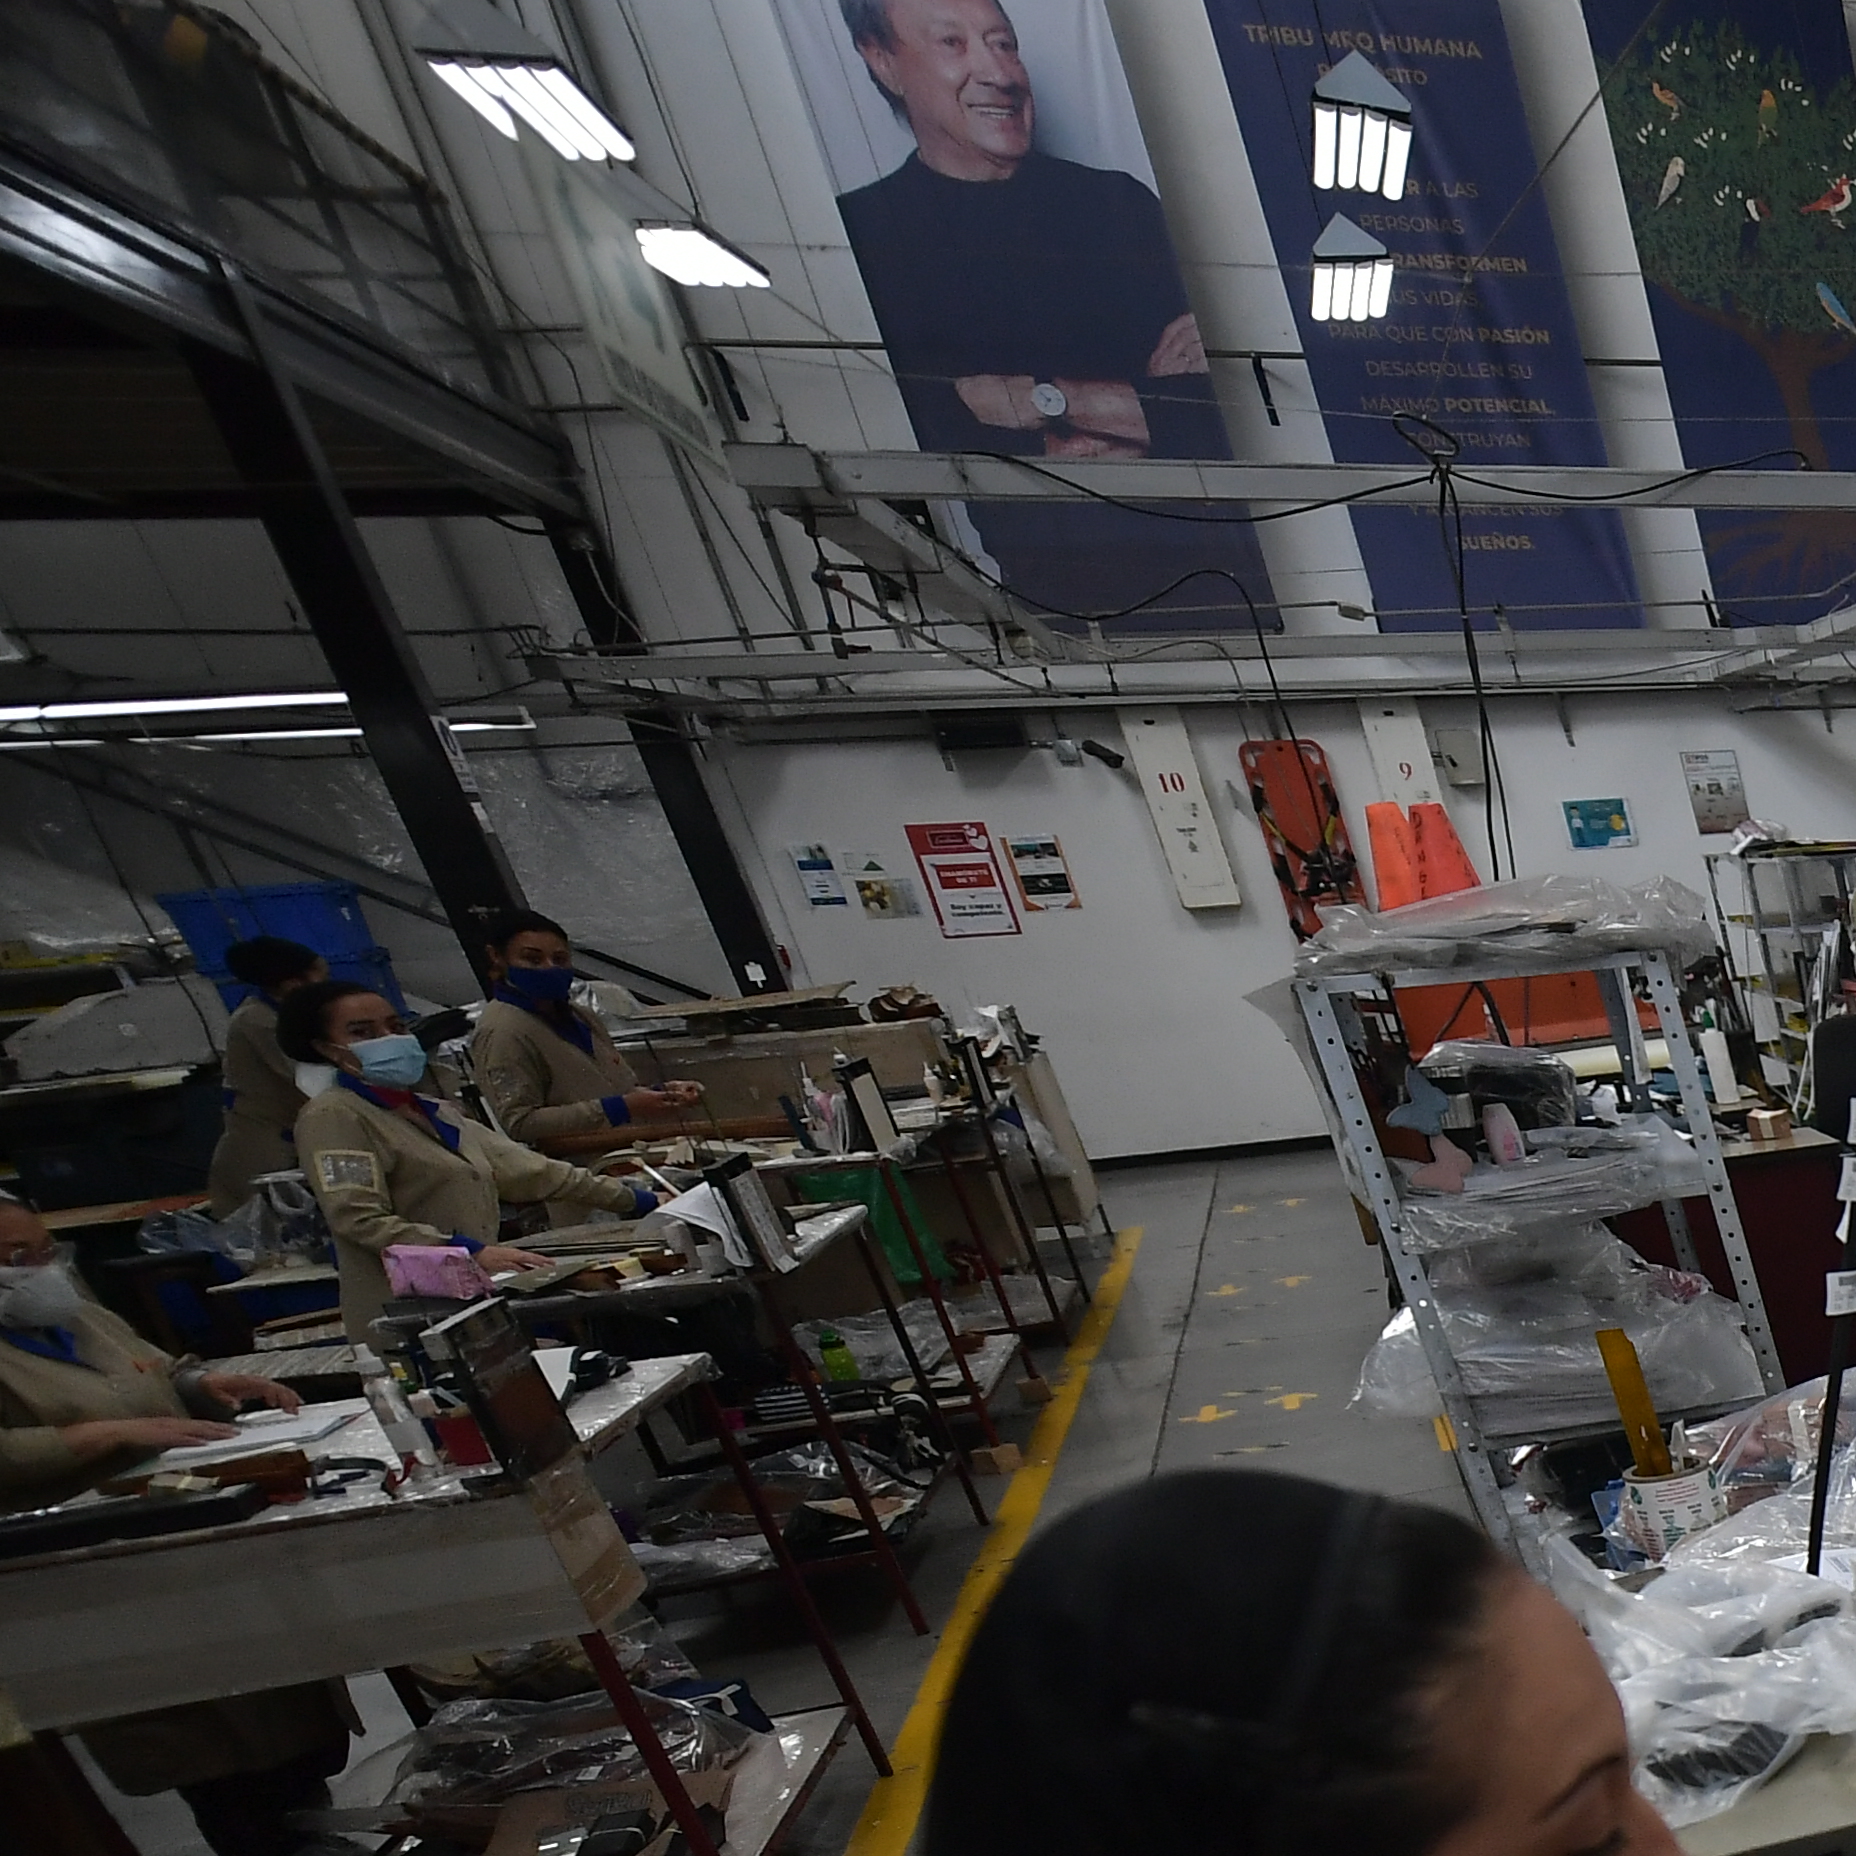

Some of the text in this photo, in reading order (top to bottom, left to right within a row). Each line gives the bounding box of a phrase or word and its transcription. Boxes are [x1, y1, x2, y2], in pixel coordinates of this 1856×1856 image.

[1242, 24, 1313, 46] TRIBU
[1380, 35, 1483, 60] HUMANA
[1443, 182, 1479, 197] LAS
[1359, 213, 1465, 235] PERSONAS
[1393, 252, 1528, 273] RANSFORMEN
[1391, 289, 1418, 305] US
[1328, 323, 1550, 345] PARA QUE CON PASIÓN
[1364, 360, 1533, 381] DESARROLLEN SU
[1398, 761, 1413, 781] 9
[1158, 772, 1186, 794] 10
